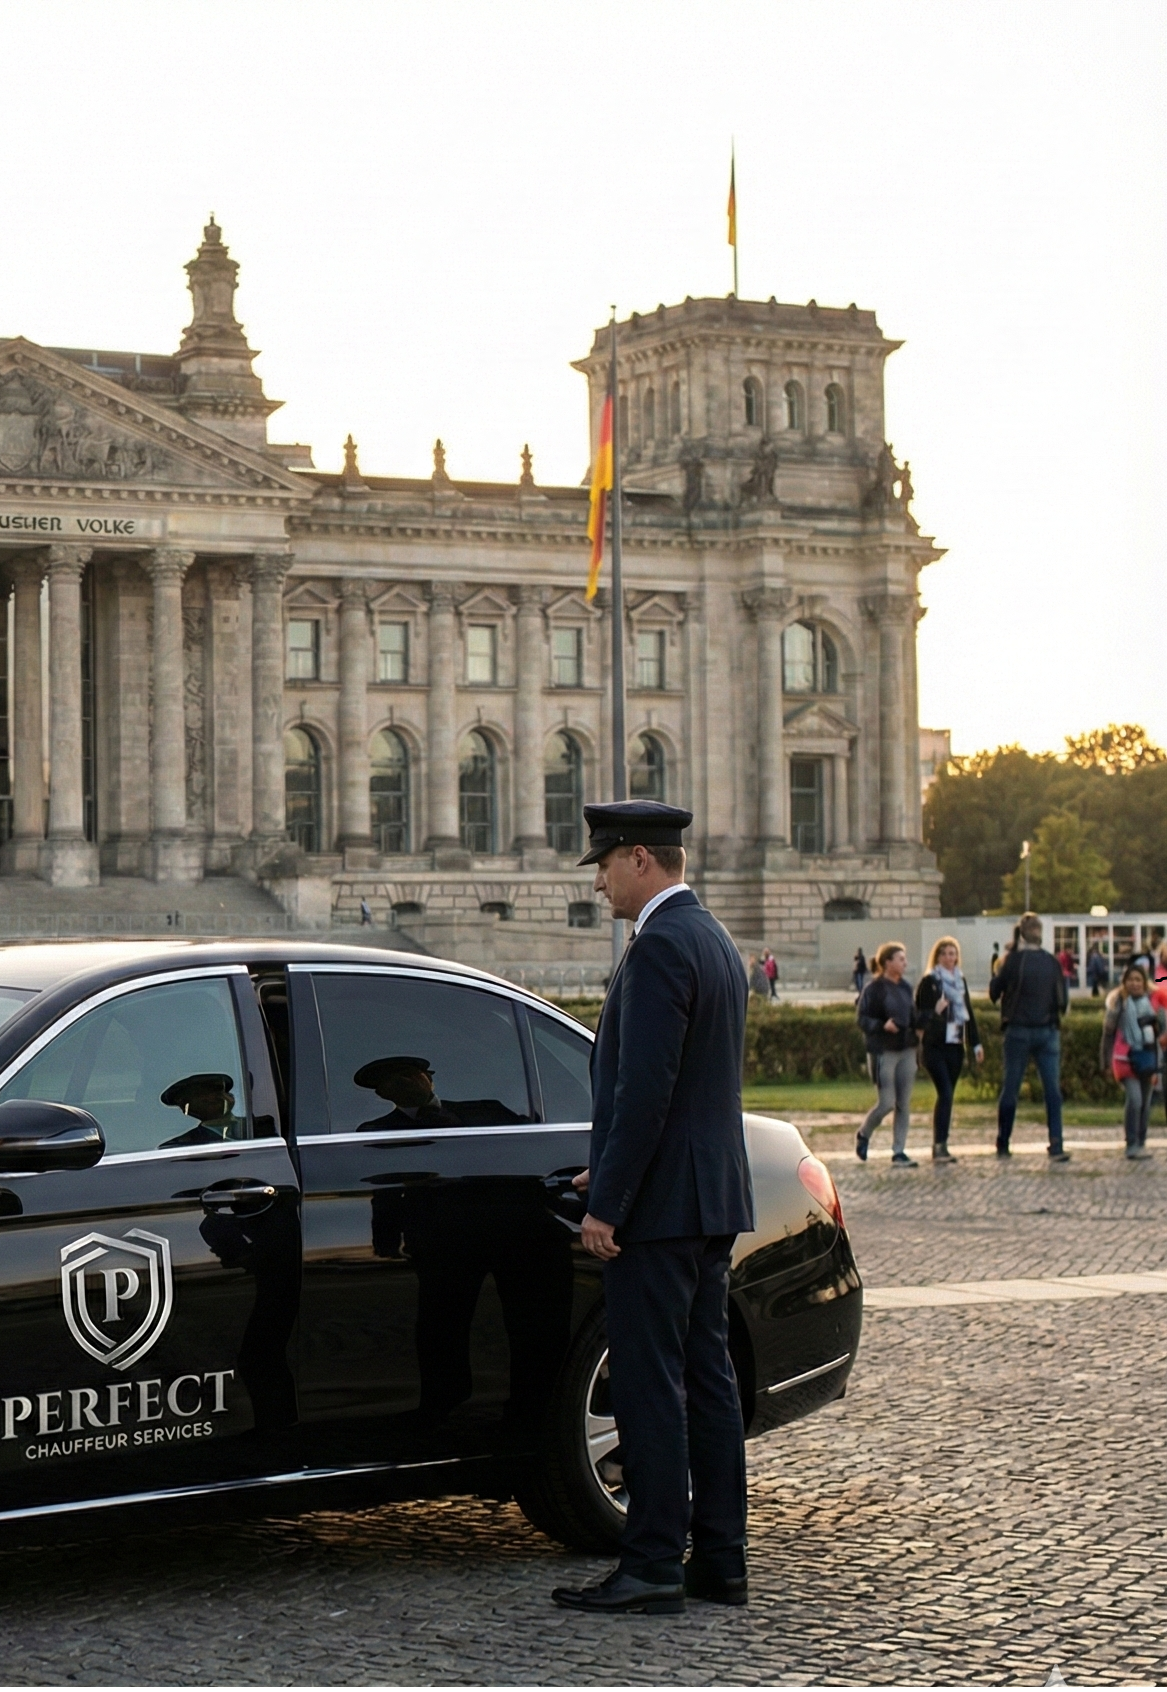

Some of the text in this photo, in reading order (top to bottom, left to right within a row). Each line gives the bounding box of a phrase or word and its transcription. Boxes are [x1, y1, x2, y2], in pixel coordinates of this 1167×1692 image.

[77, 518, 135, 534] VOLKE
[99, 1268, 139, 1323] P
[1, 1369, 234, 1440] PERFECT
[25, 1421, 213, 1459] CHAUFFEUR SERVICES
